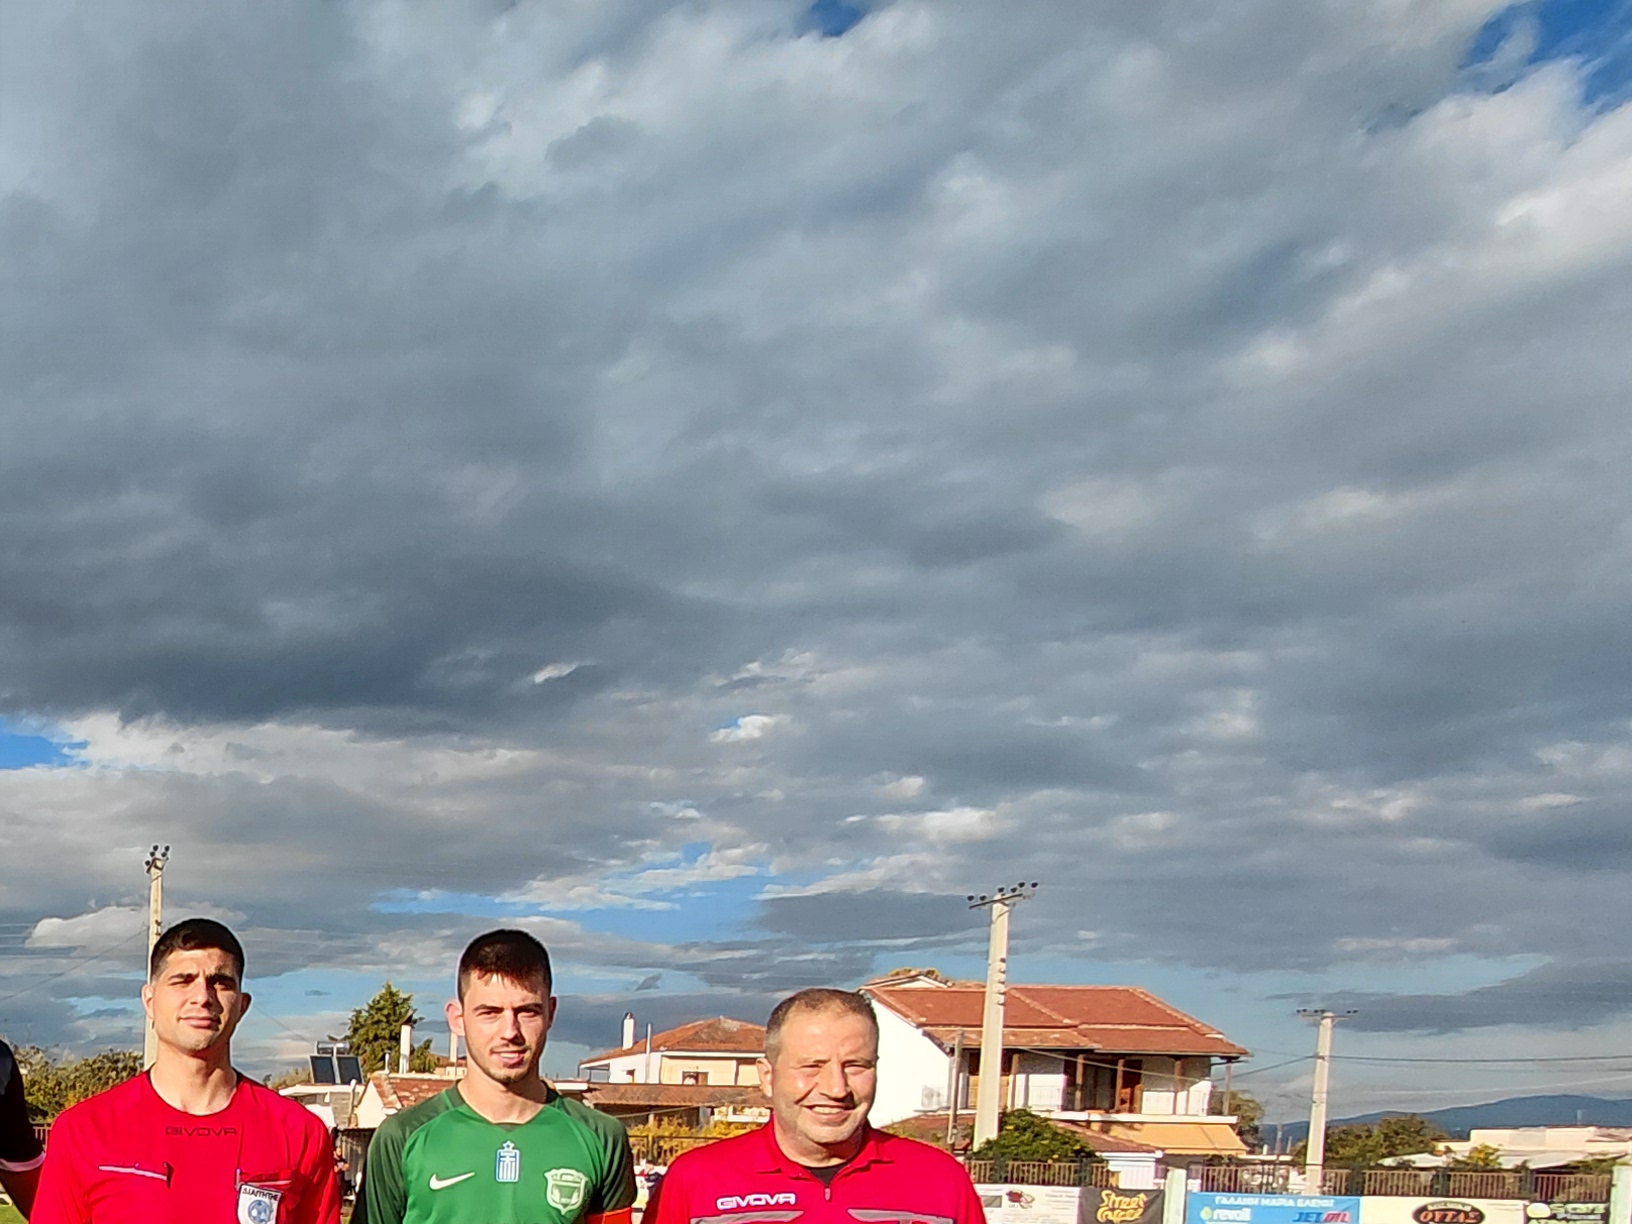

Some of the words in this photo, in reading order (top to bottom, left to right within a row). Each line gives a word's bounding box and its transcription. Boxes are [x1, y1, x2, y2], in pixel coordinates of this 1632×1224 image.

[165, 1126, 237, 1137] GIVOVA
[717, 1193, 796, 1210] GIVOVA
[1099, 1189, 1147, 1209] Street
[1213, 1207, 1251, 1221] revoil
